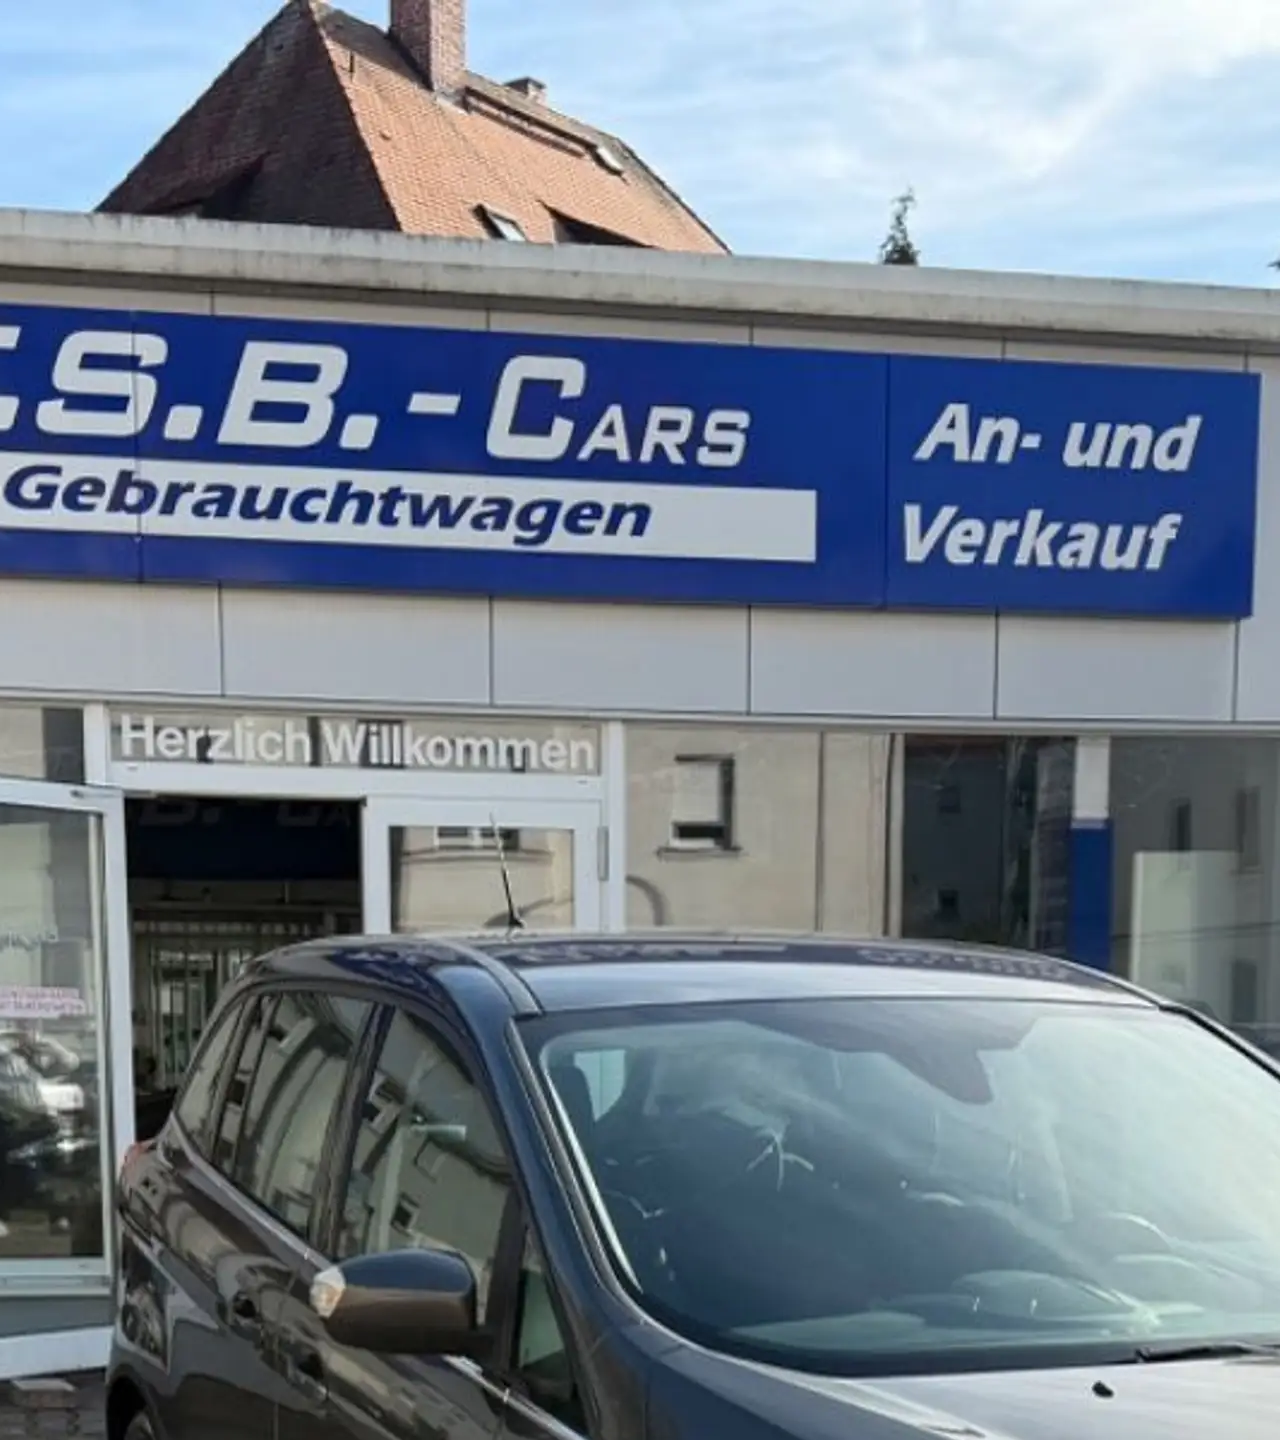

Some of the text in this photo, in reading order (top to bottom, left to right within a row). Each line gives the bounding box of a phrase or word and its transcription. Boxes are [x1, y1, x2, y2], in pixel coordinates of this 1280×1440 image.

[914, 403, 1202, 471] An- und
[2, 464, 653, 547] Gebrauchtwagen
[903, 504, 1182, 570] Verkauf
[121, 713, 595, 769] Herzlich Willkommen
